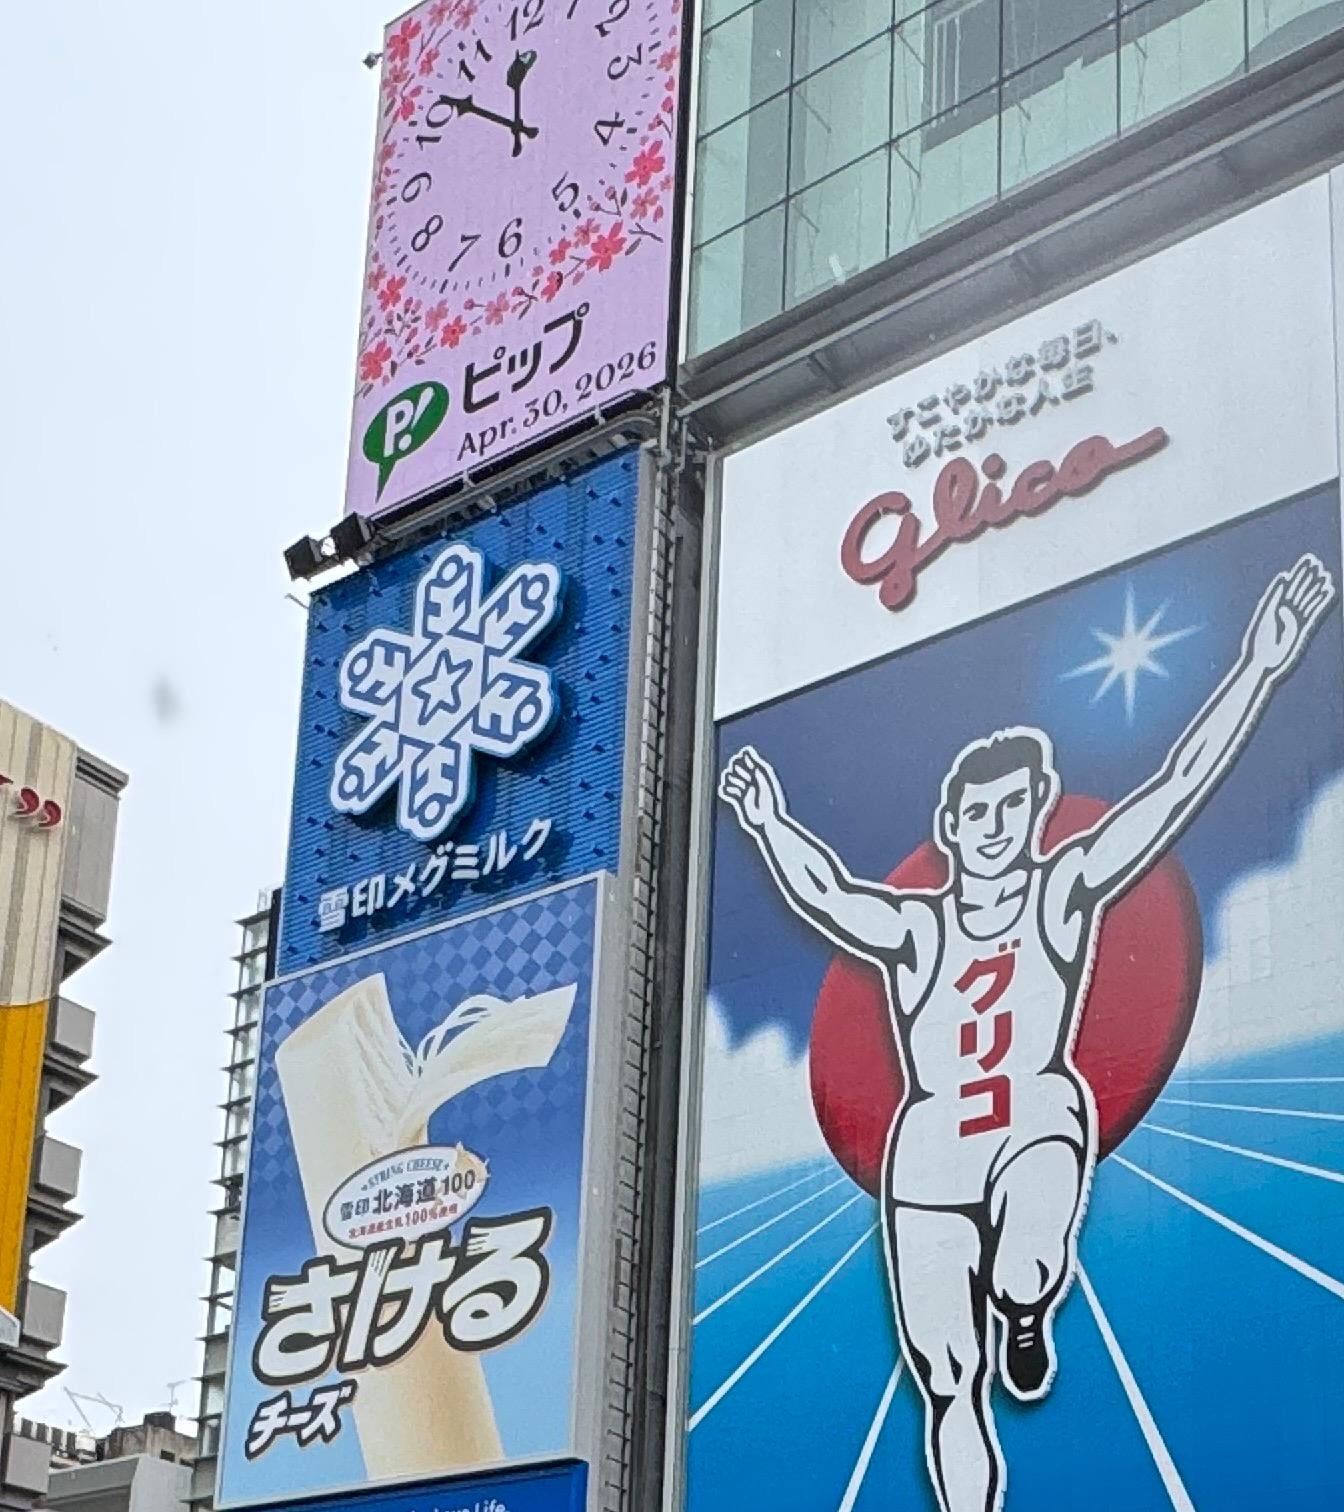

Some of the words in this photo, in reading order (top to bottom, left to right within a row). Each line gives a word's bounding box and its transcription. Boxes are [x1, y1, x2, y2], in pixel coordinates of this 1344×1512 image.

[456, 38, 493, 83] 11
[607, 43, 643, 80] 3
[593, 110, 625, 146] 4
[400, 171, 433, 204] 9
[552, 172, 580, 212] 5
[410, 214, 444, 252] 8
[448, 233, 482, 272] 7
[497, 217, 523, 258] 6
[462, 301, 590, 414] ピップ
[457, 420, 517, 462] Apr.
[522, 391, 569, 432] 30,
[575, 340, 658, 403] 2026
[902, 363, 1094, 470] ゆたかな人生
[317, 818, 553, 933] 雪印メグミルク
[953, 938, 1021, 1138] グリコ
[254, 1206, 552, 1385] さける
[245, 1380, 358, 1460] チーズ
